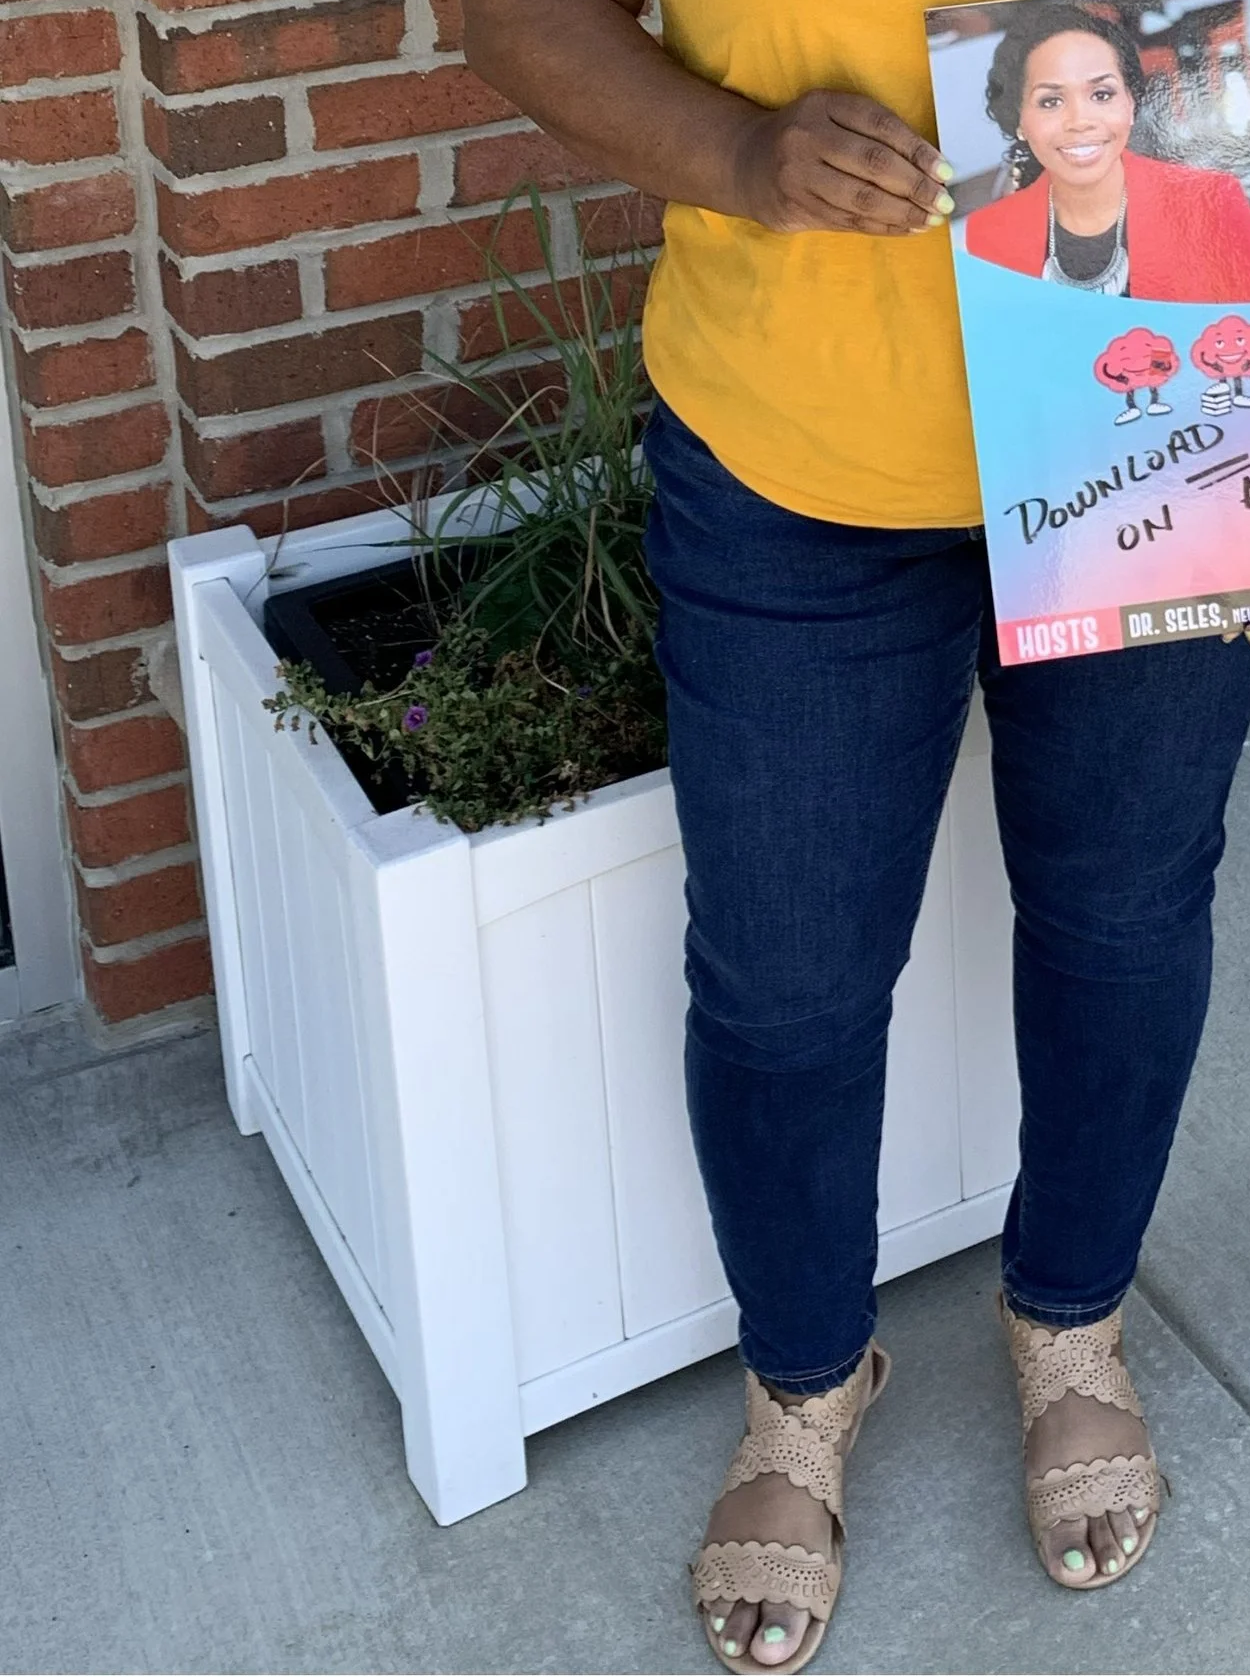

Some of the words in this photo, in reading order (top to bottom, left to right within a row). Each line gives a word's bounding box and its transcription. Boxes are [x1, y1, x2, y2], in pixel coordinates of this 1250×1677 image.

[1116, 504, 1173, 551] ON
[1016, 616, 1100, 659] HOSTS
[1128, 612, 1161, 639] DR.
[1165, 602, 1229, 631] SELES,
